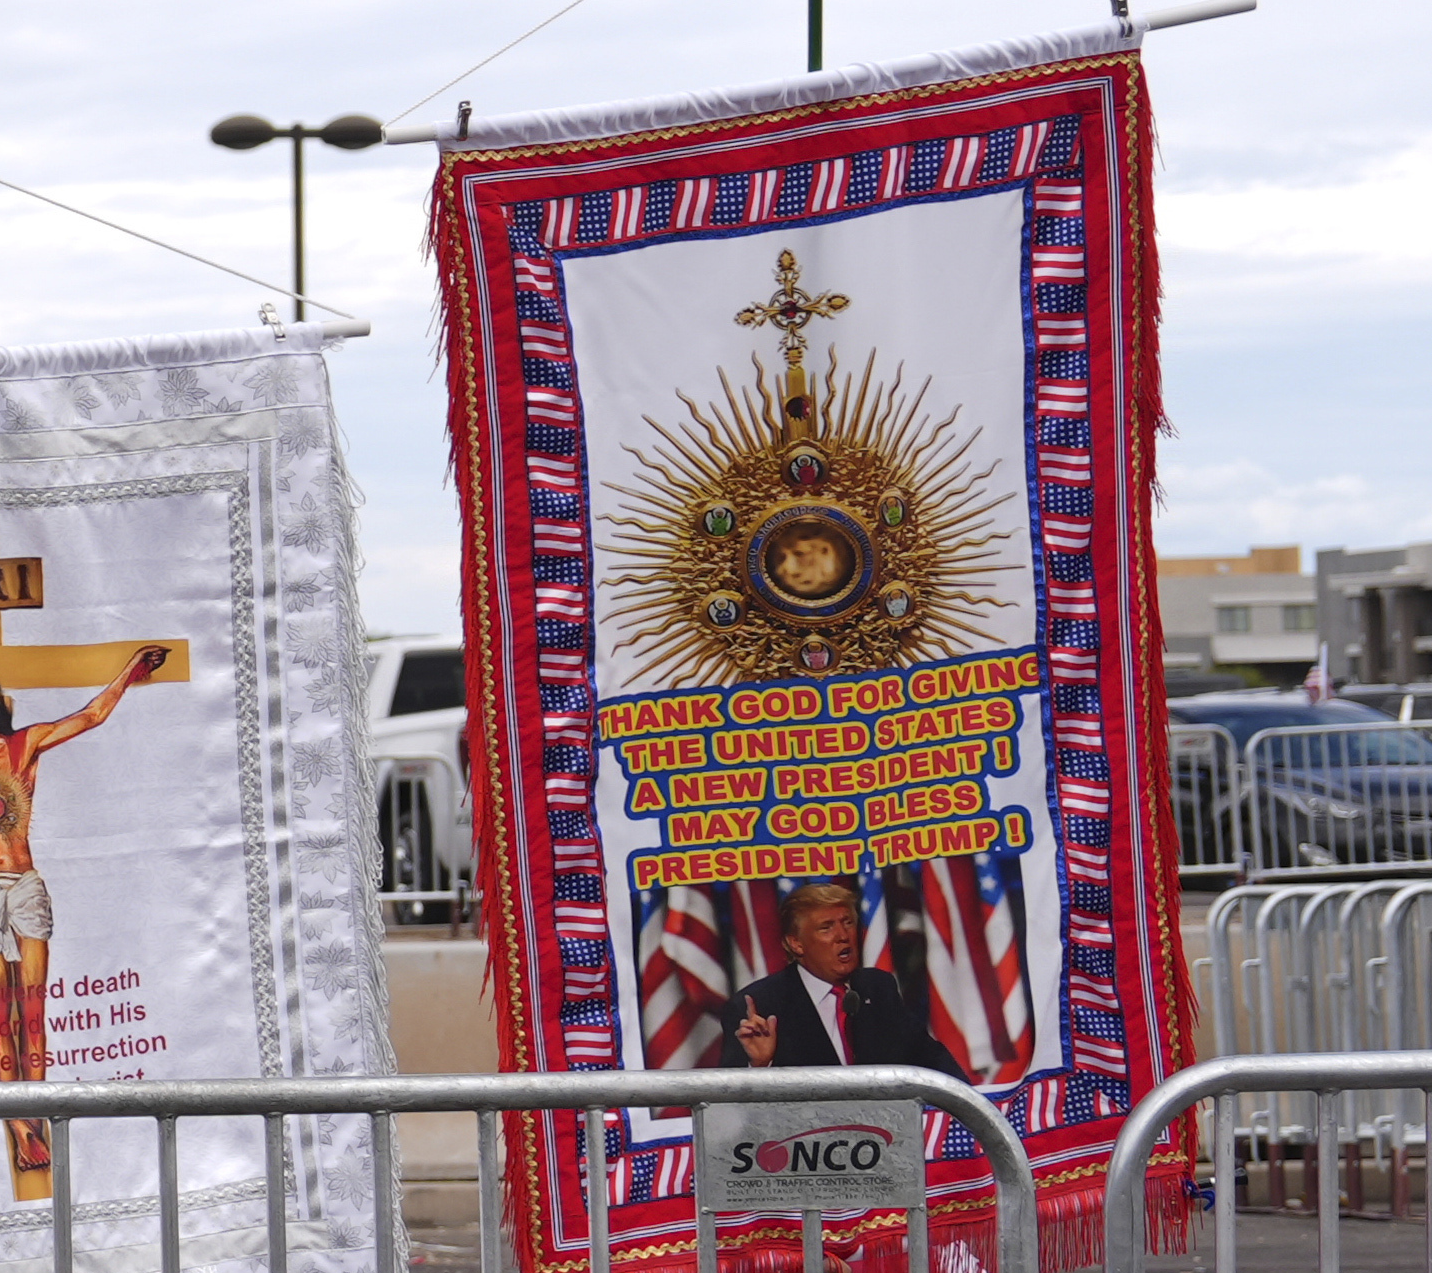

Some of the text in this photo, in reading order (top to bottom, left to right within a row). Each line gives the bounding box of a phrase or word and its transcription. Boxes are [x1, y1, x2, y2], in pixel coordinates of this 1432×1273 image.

[600, 655, 1039, 739] THANK GOD FOR GIVING
[624, 701, 1012, 771] THE UNITED STATES
[636, 780, 662, 809] A
[674, 771, 764, 804] NEW
[778, 743, 983, 795] PRESIDENT
[672, 785, 981, 843] MAY GOD BLESS
[637, 843, 861, 886] PRESIDENT
[871, 821, 997, 866] TRUMP
[74, 968, 140, 997] death
[49, 1008, 100, 1033] with
[110, 1001, 146, 1025] His
[23, 1034, 167, 1070] esurrection
[731, 1139, 881, 1173] SONCO
